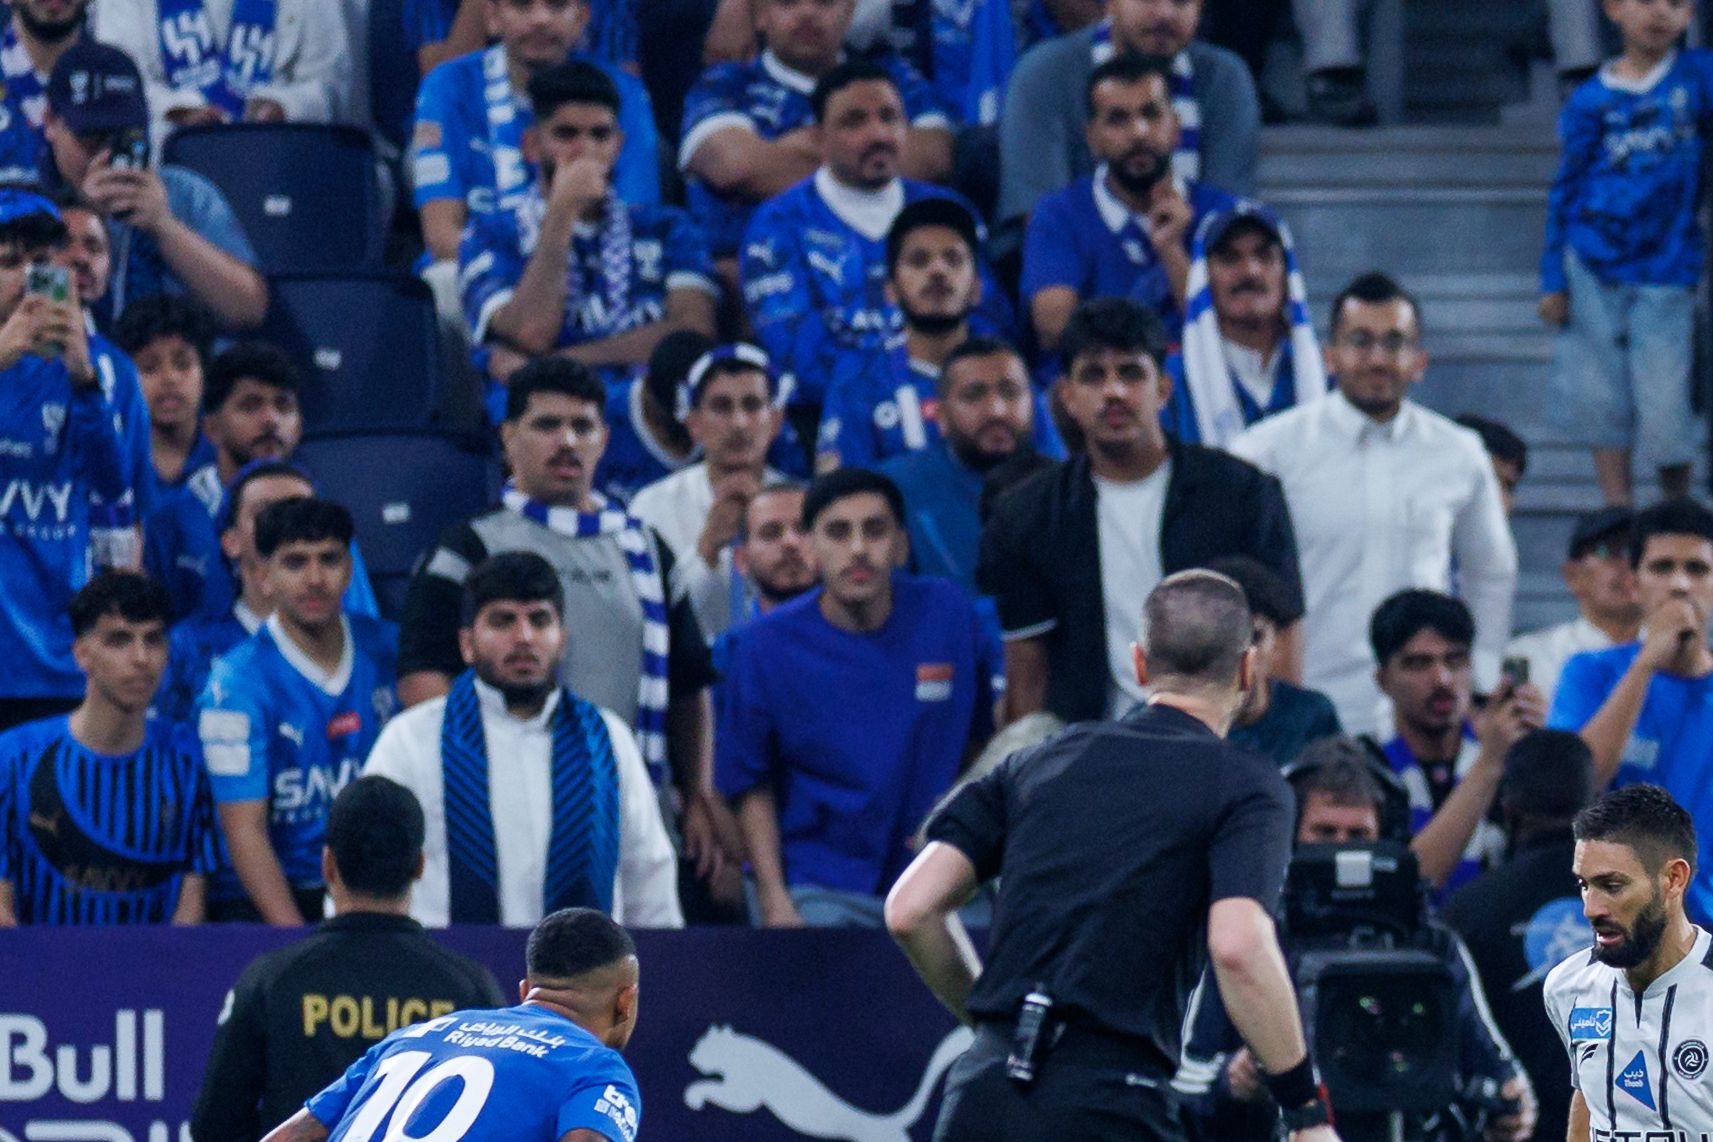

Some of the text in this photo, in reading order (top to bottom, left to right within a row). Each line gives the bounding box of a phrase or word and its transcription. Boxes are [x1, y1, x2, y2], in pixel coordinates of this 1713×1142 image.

[0, 1008, 164, 1104] Bull
[443, 1030, 550, 1058] Riyad Bank
